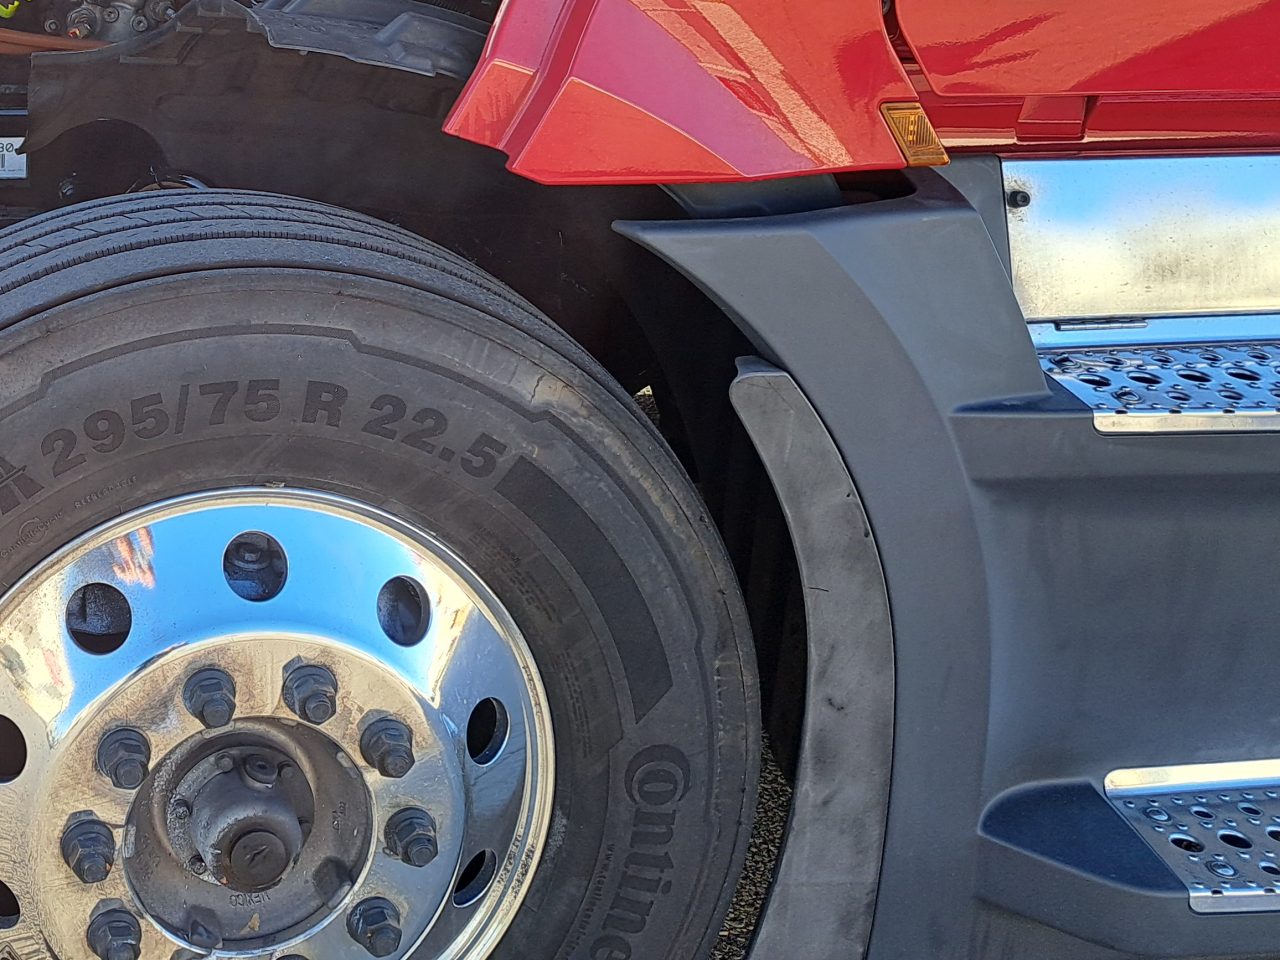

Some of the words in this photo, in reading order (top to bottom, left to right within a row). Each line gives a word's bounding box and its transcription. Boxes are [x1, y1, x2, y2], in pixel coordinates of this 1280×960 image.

[40, 378, 282, 479] 295/75
[301, 380, 349, 428] R
[361, 393, 508, 479] 22.5
